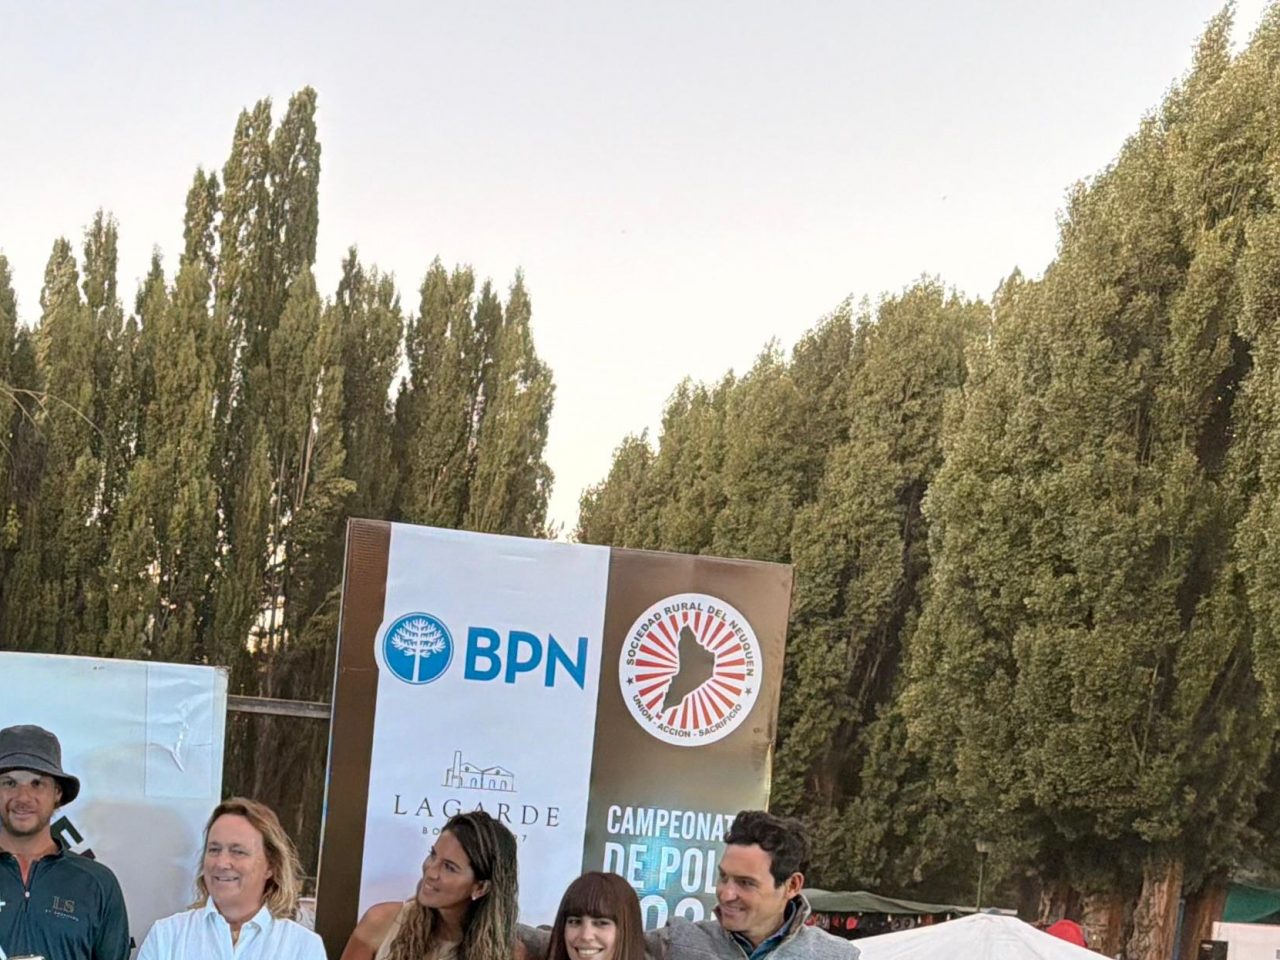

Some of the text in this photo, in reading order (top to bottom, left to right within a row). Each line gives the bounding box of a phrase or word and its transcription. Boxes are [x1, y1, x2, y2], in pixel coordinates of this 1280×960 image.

[463, 626, 589, 691] BPN
[627, 602, 755, 677] SOCIEDAD RURAL DEL NEUQUEN
[633, 694, 743, 738] UNION ACCION SACRIFICIO
[607, 804, 737, 842] CAMPEONAT
[602, 841, 717, 894] DE POL
